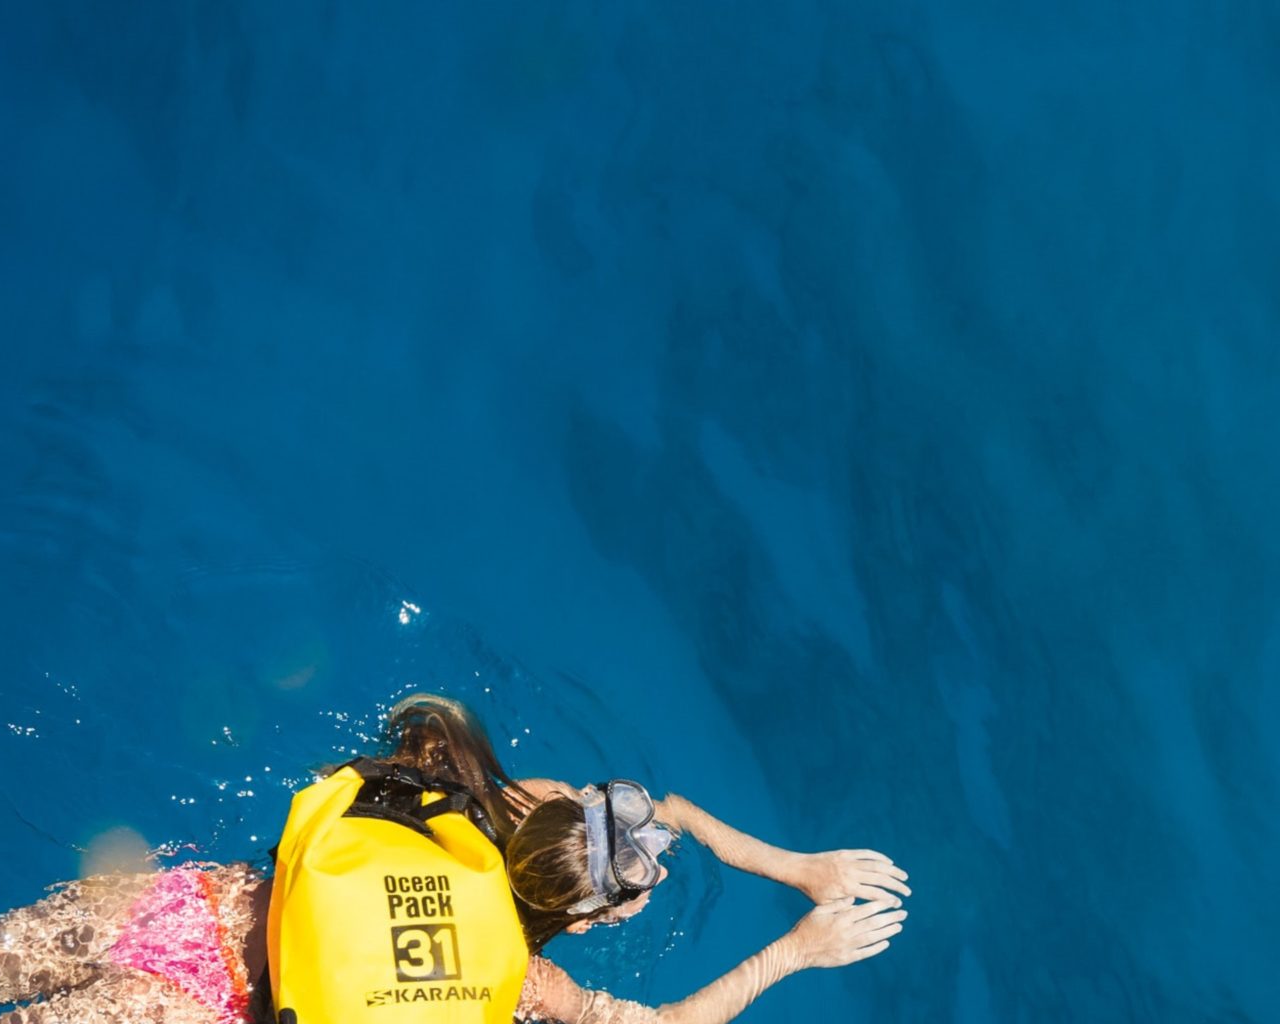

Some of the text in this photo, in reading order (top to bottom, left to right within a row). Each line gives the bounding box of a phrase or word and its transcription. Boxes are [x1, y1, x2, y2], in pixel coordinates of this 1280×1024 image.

[384, 875, 450, 893] Ocean
[387, 893, 454, 919] Pack
[397, 928, 458, 977] 31
[395, 986, 492, 1003] KARANA
